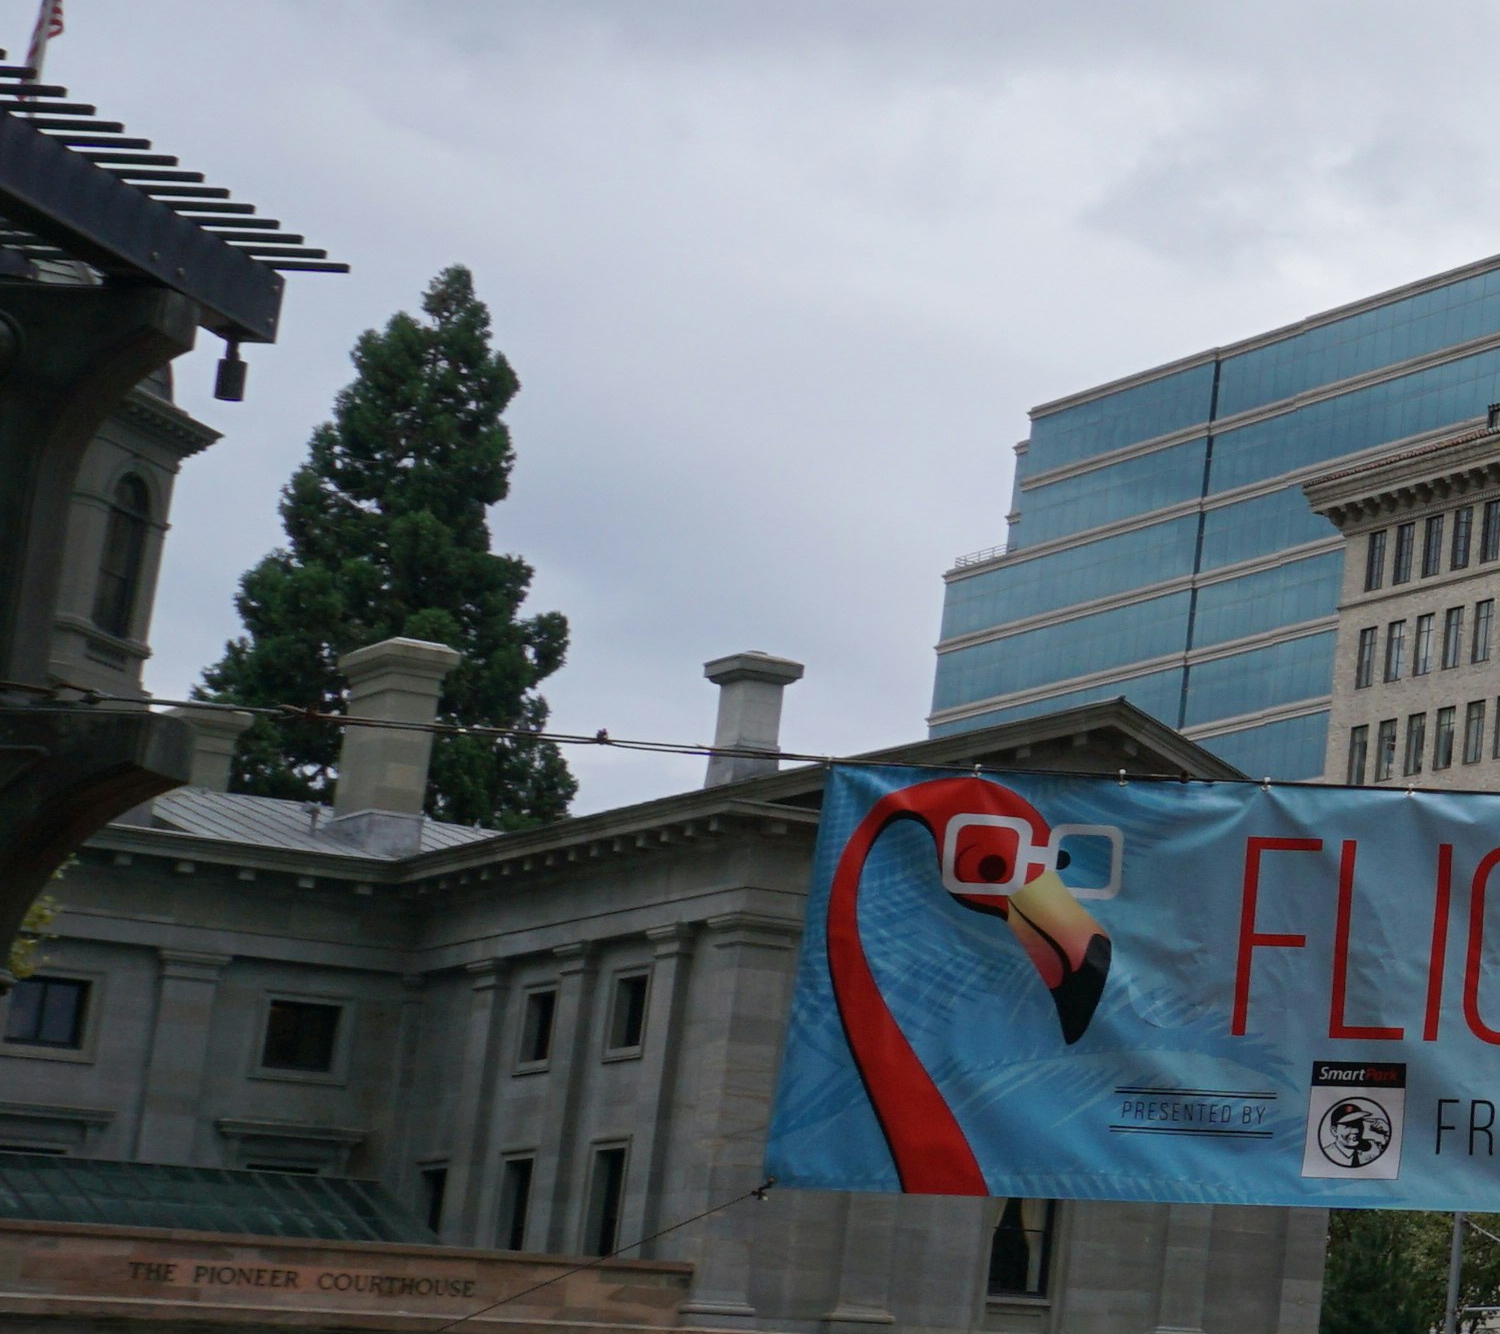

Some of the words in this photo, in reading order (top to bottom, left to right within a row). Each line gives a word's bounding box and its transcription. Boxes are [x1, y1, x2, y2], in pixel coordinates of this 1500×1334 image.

[1318, 1065, 1399, 1082] SmartPark
[1120, 1100, 1232, 1124] PRESENTED
[1241, 1105, 1268, 1125] BY
[128, 1261, 179, 1284] THE
[192, 1264, 300, 1290] PIONEER
[316, 1271, 477, 1299] COURTHOUSE
